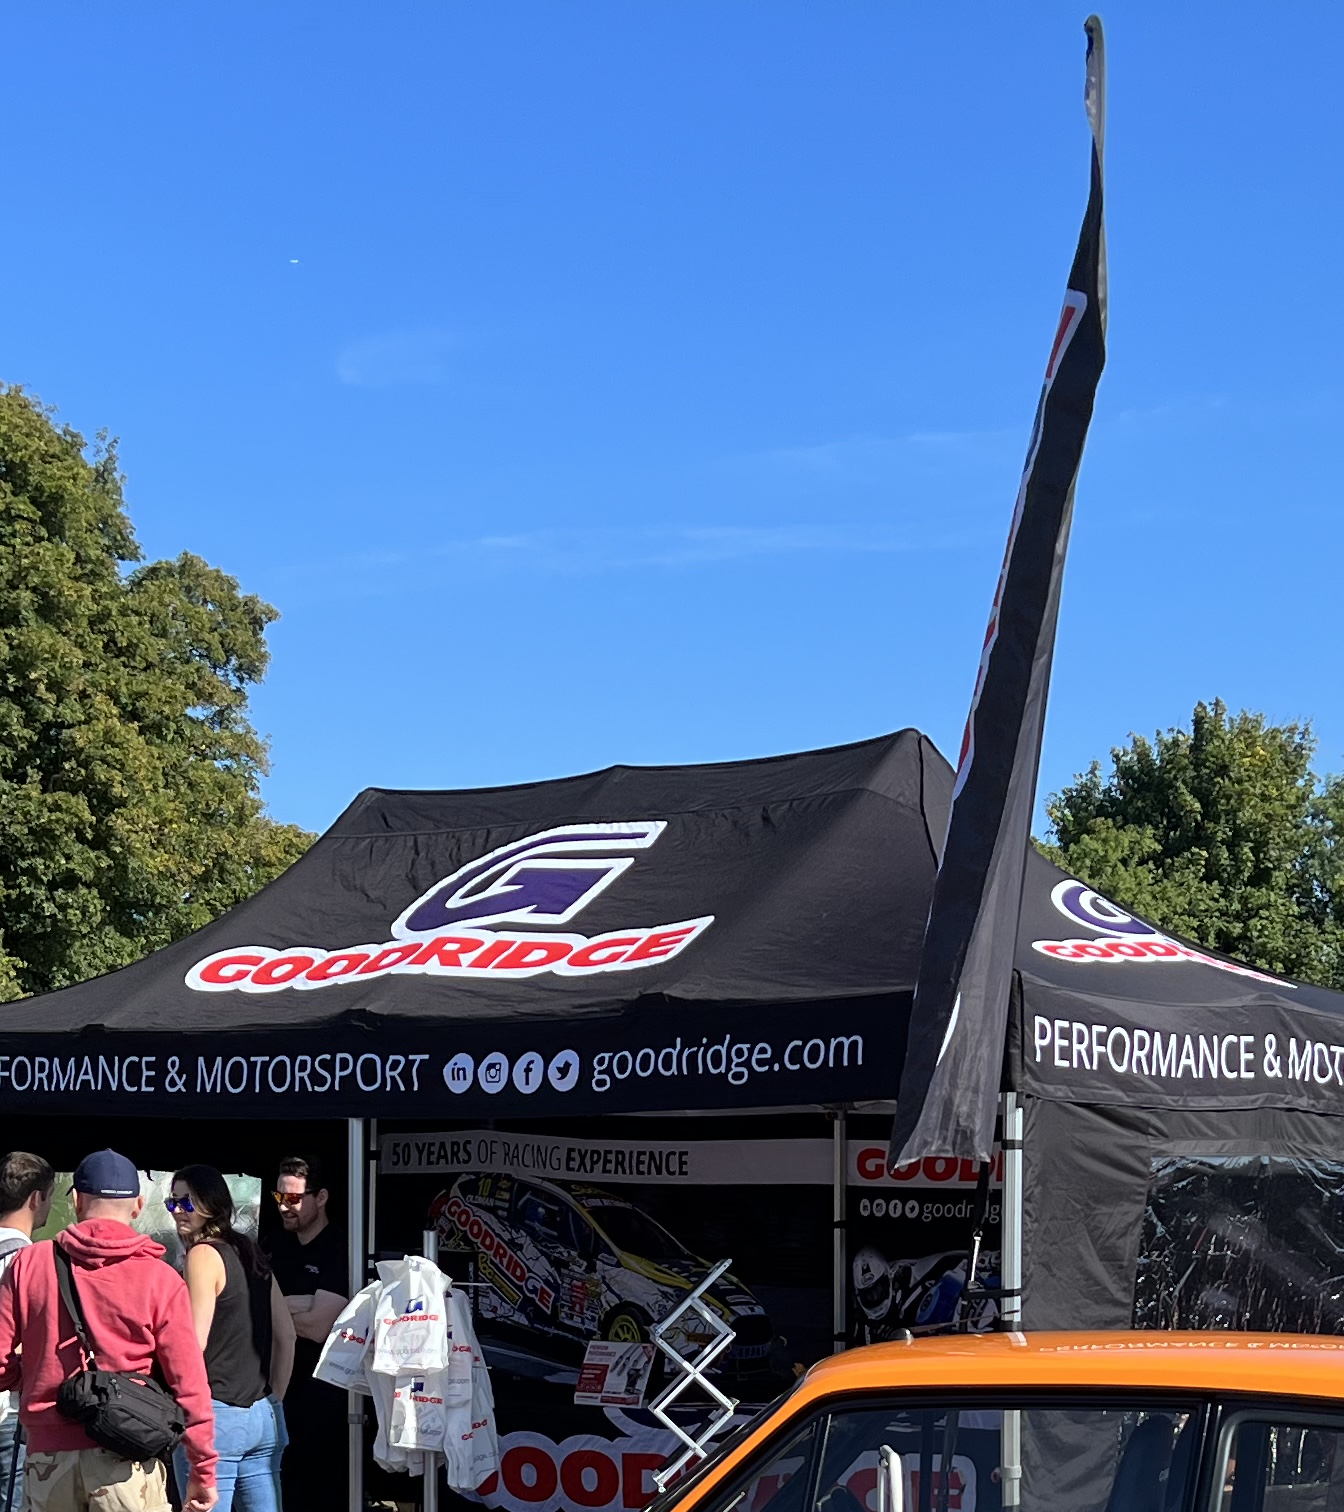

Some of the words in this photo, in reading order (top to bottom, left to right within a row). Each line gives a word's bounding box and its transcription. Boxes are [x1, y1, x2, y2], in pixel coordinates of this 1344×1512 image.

[199, 925, 696, 985] GOODRIDGE
[165, 1055, 187, 1092] &
[196, 1052, 430, 1094] MOTORSPORT
[591, 1034, 864, 1091] goodridge.com
[1034, 1015, 1255, 1079] PERFORMANCE
[1264, 1034, 1283, 1079] &
[392, 1142, 411, 1167] 50
[413, 1140, 473, 1167] YEARS
[477, 1139, 499, 1165] OF
[503, 1142, 562, 1171] RACING
[565, 1147, 689, 1176] EXPERIENCE
[447, 1198, 555, 1310] GOODRIDGE
